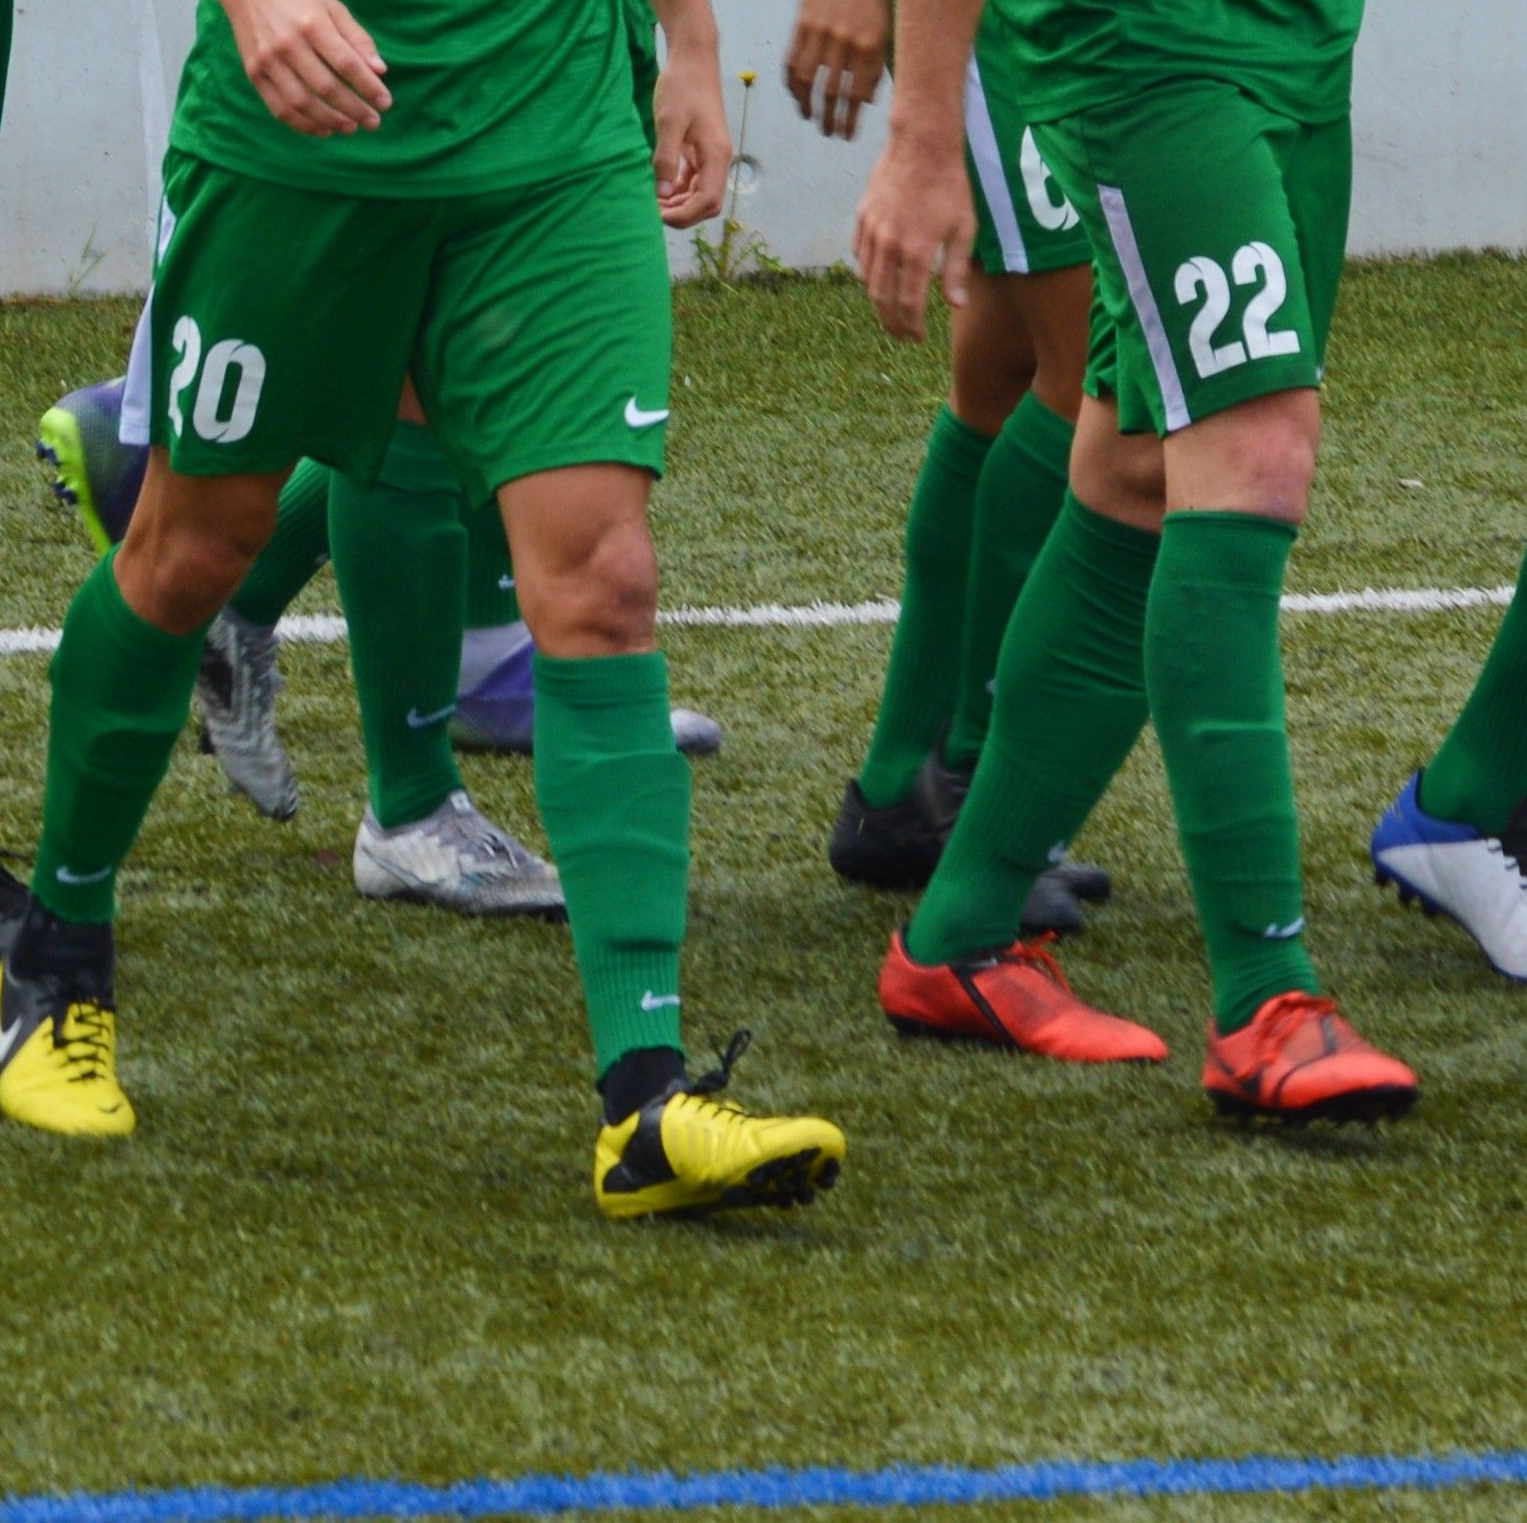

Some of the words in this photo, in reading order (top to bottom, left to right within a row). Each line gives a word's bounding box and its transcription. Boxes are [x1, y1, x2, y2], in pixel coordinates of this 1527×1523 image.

[1019, 124, 1081, 230] 6
[1174, 240, 1301, 378] 22
[167, 314, 267, 444] 20
